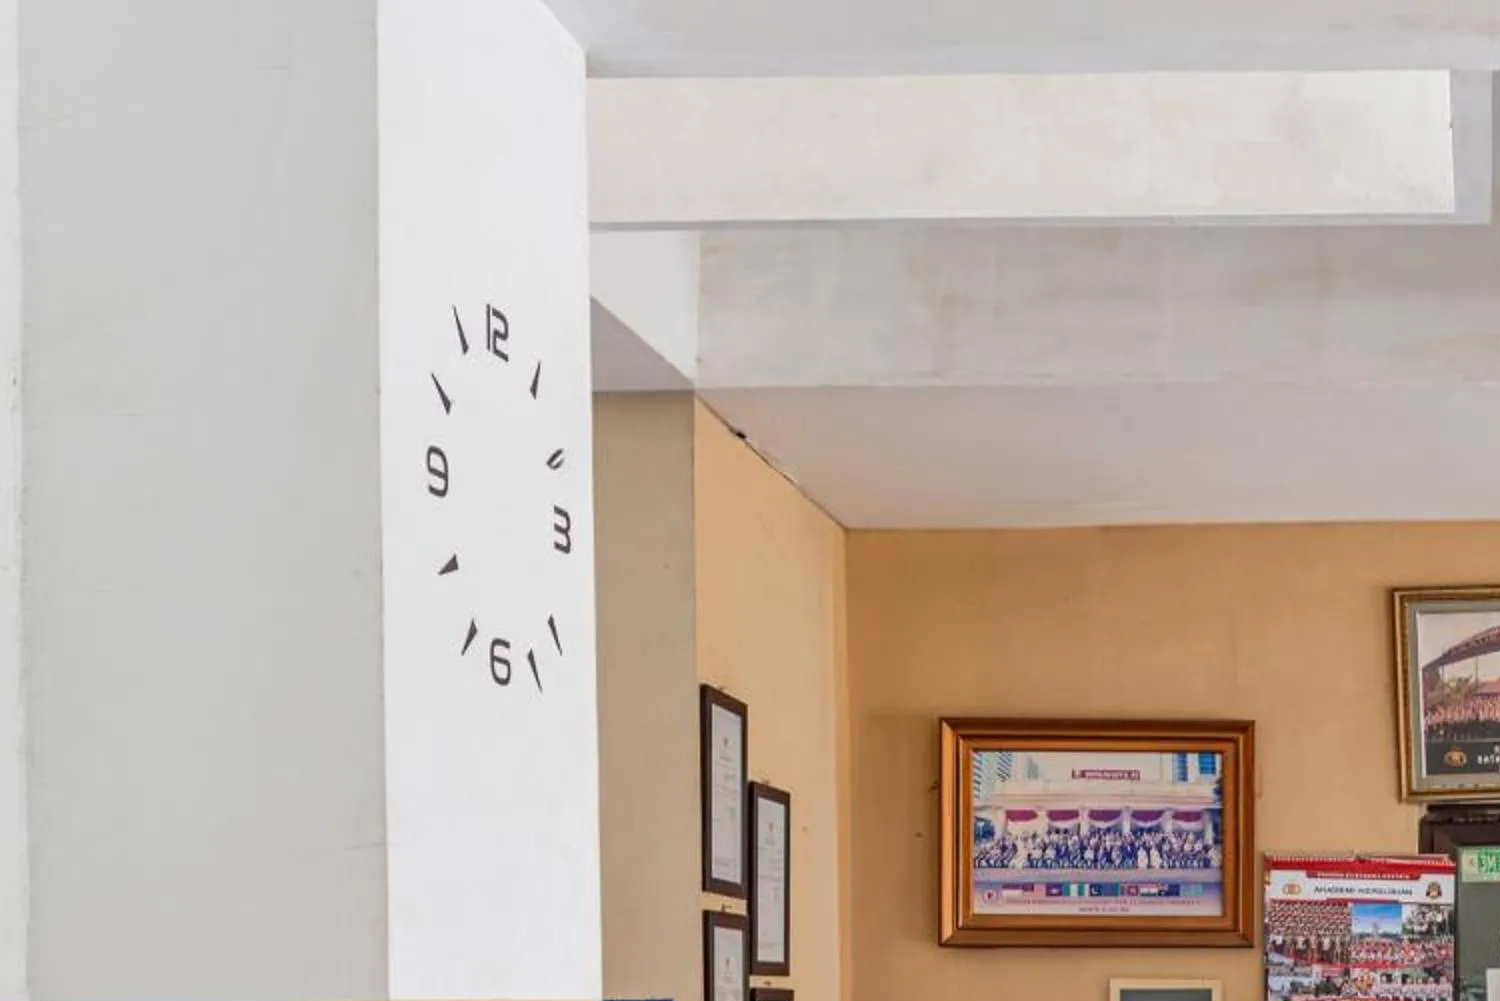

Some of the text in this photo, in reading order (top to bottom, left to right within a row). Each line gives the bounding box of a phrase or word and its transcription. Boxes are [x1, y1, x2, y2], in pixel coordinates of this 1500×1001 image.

[485, 303, 509, 362] 12
[426, 445, 449, 498] 9
[553, 505, 571, 554] 3
[489, 637, 512, 686] 6
